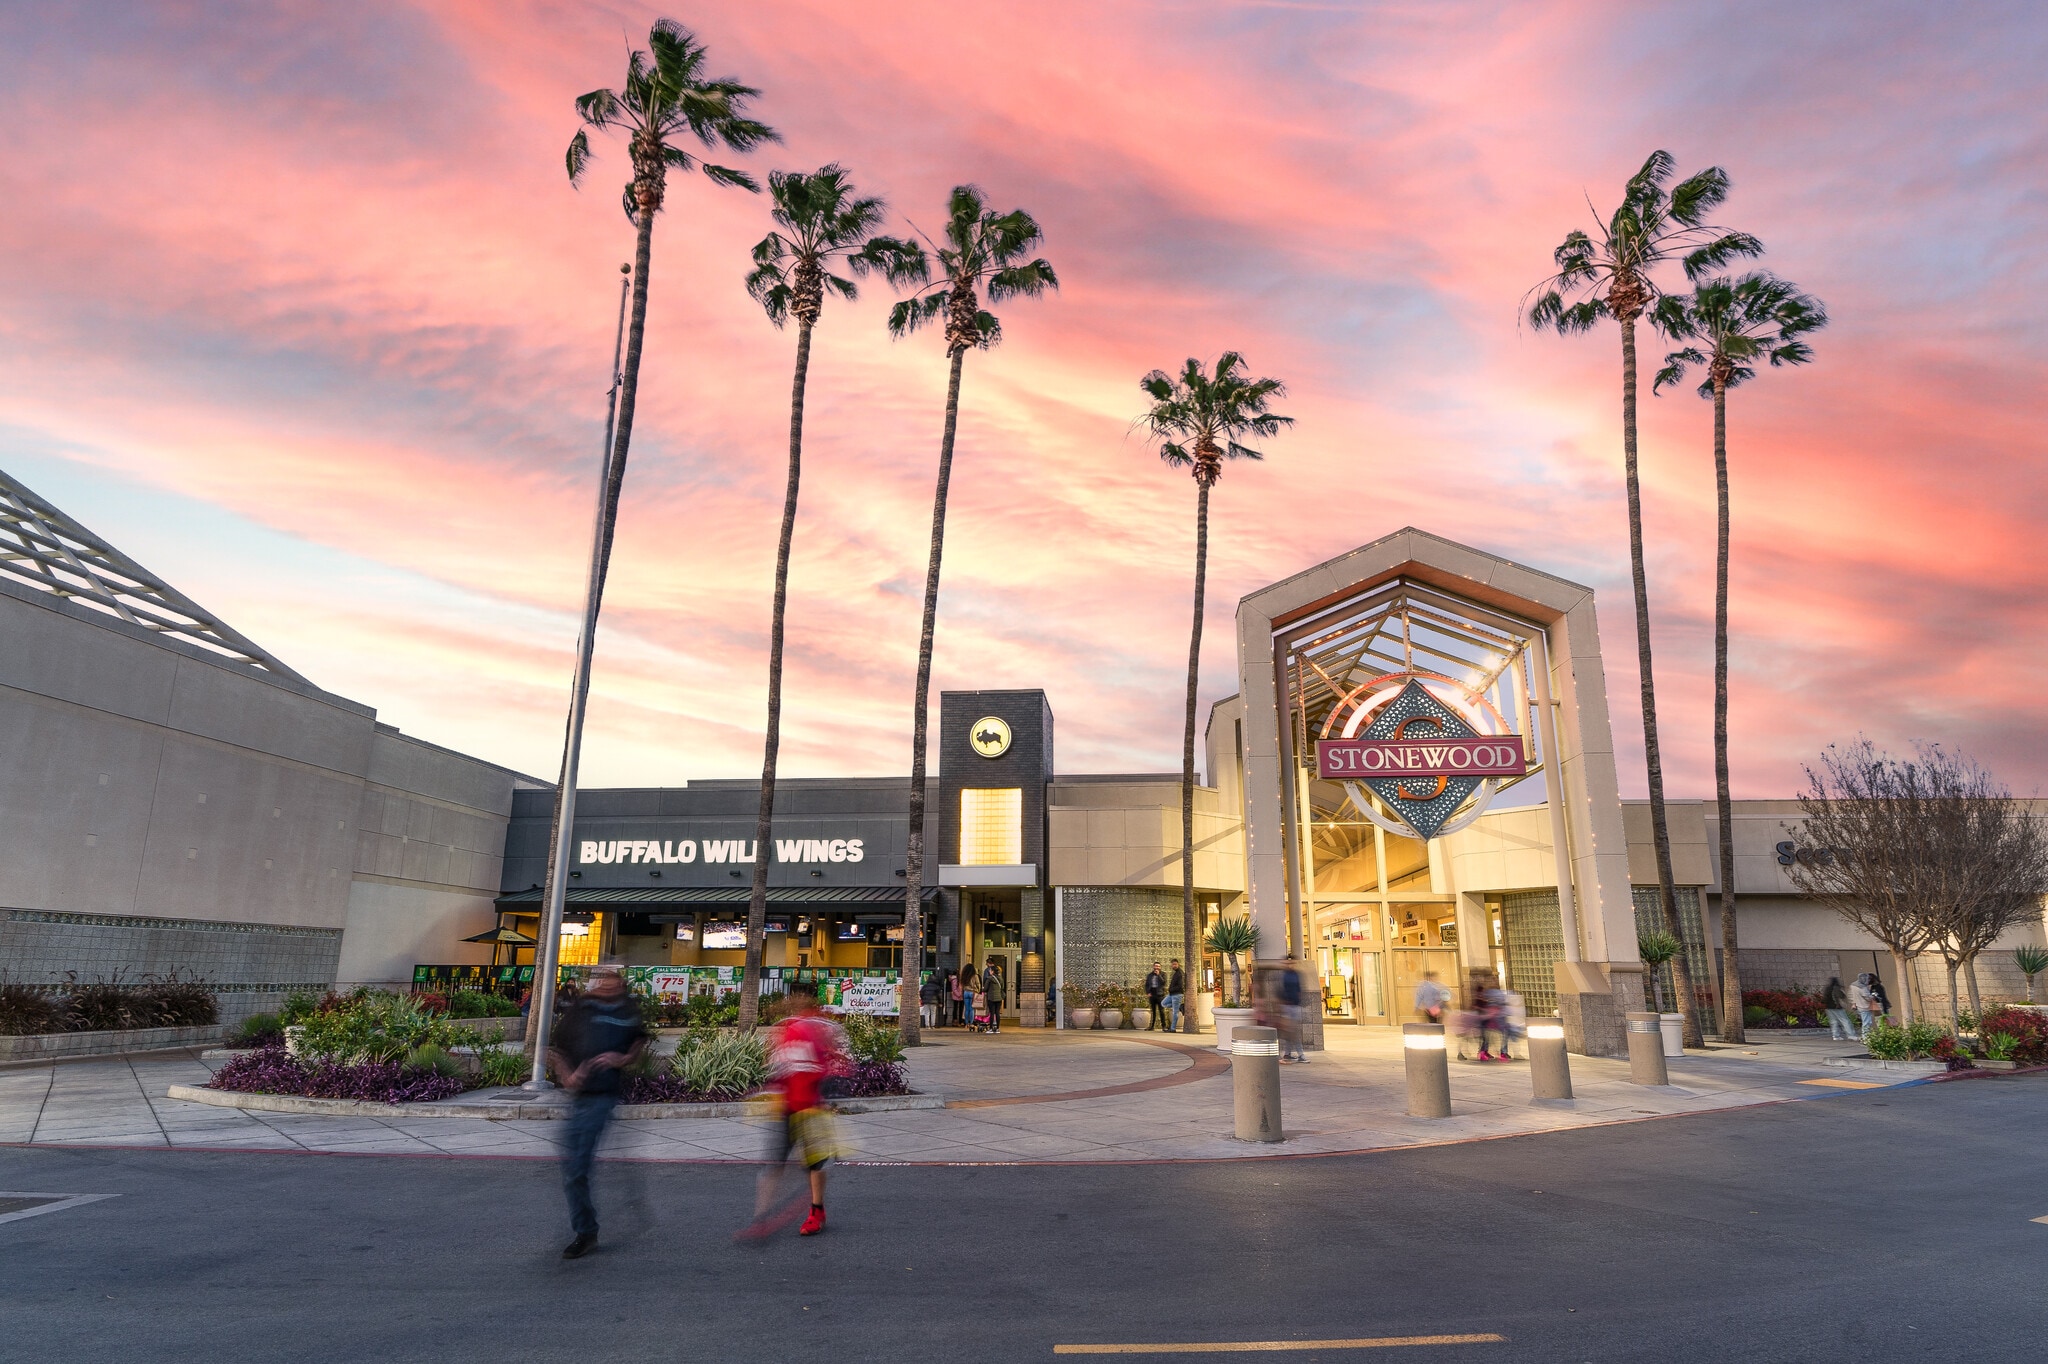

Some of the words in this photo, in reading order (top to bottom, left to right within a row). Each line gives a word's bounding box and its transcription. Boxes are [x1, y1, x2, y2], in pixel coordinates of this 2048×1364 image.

[1328, 746, 1517, 770] STONEWOOD
[580, 840, 697, 864] BUFFALO
[702, 840, 758, 864] WIL
[775, 839, 864, 863] WINGS
